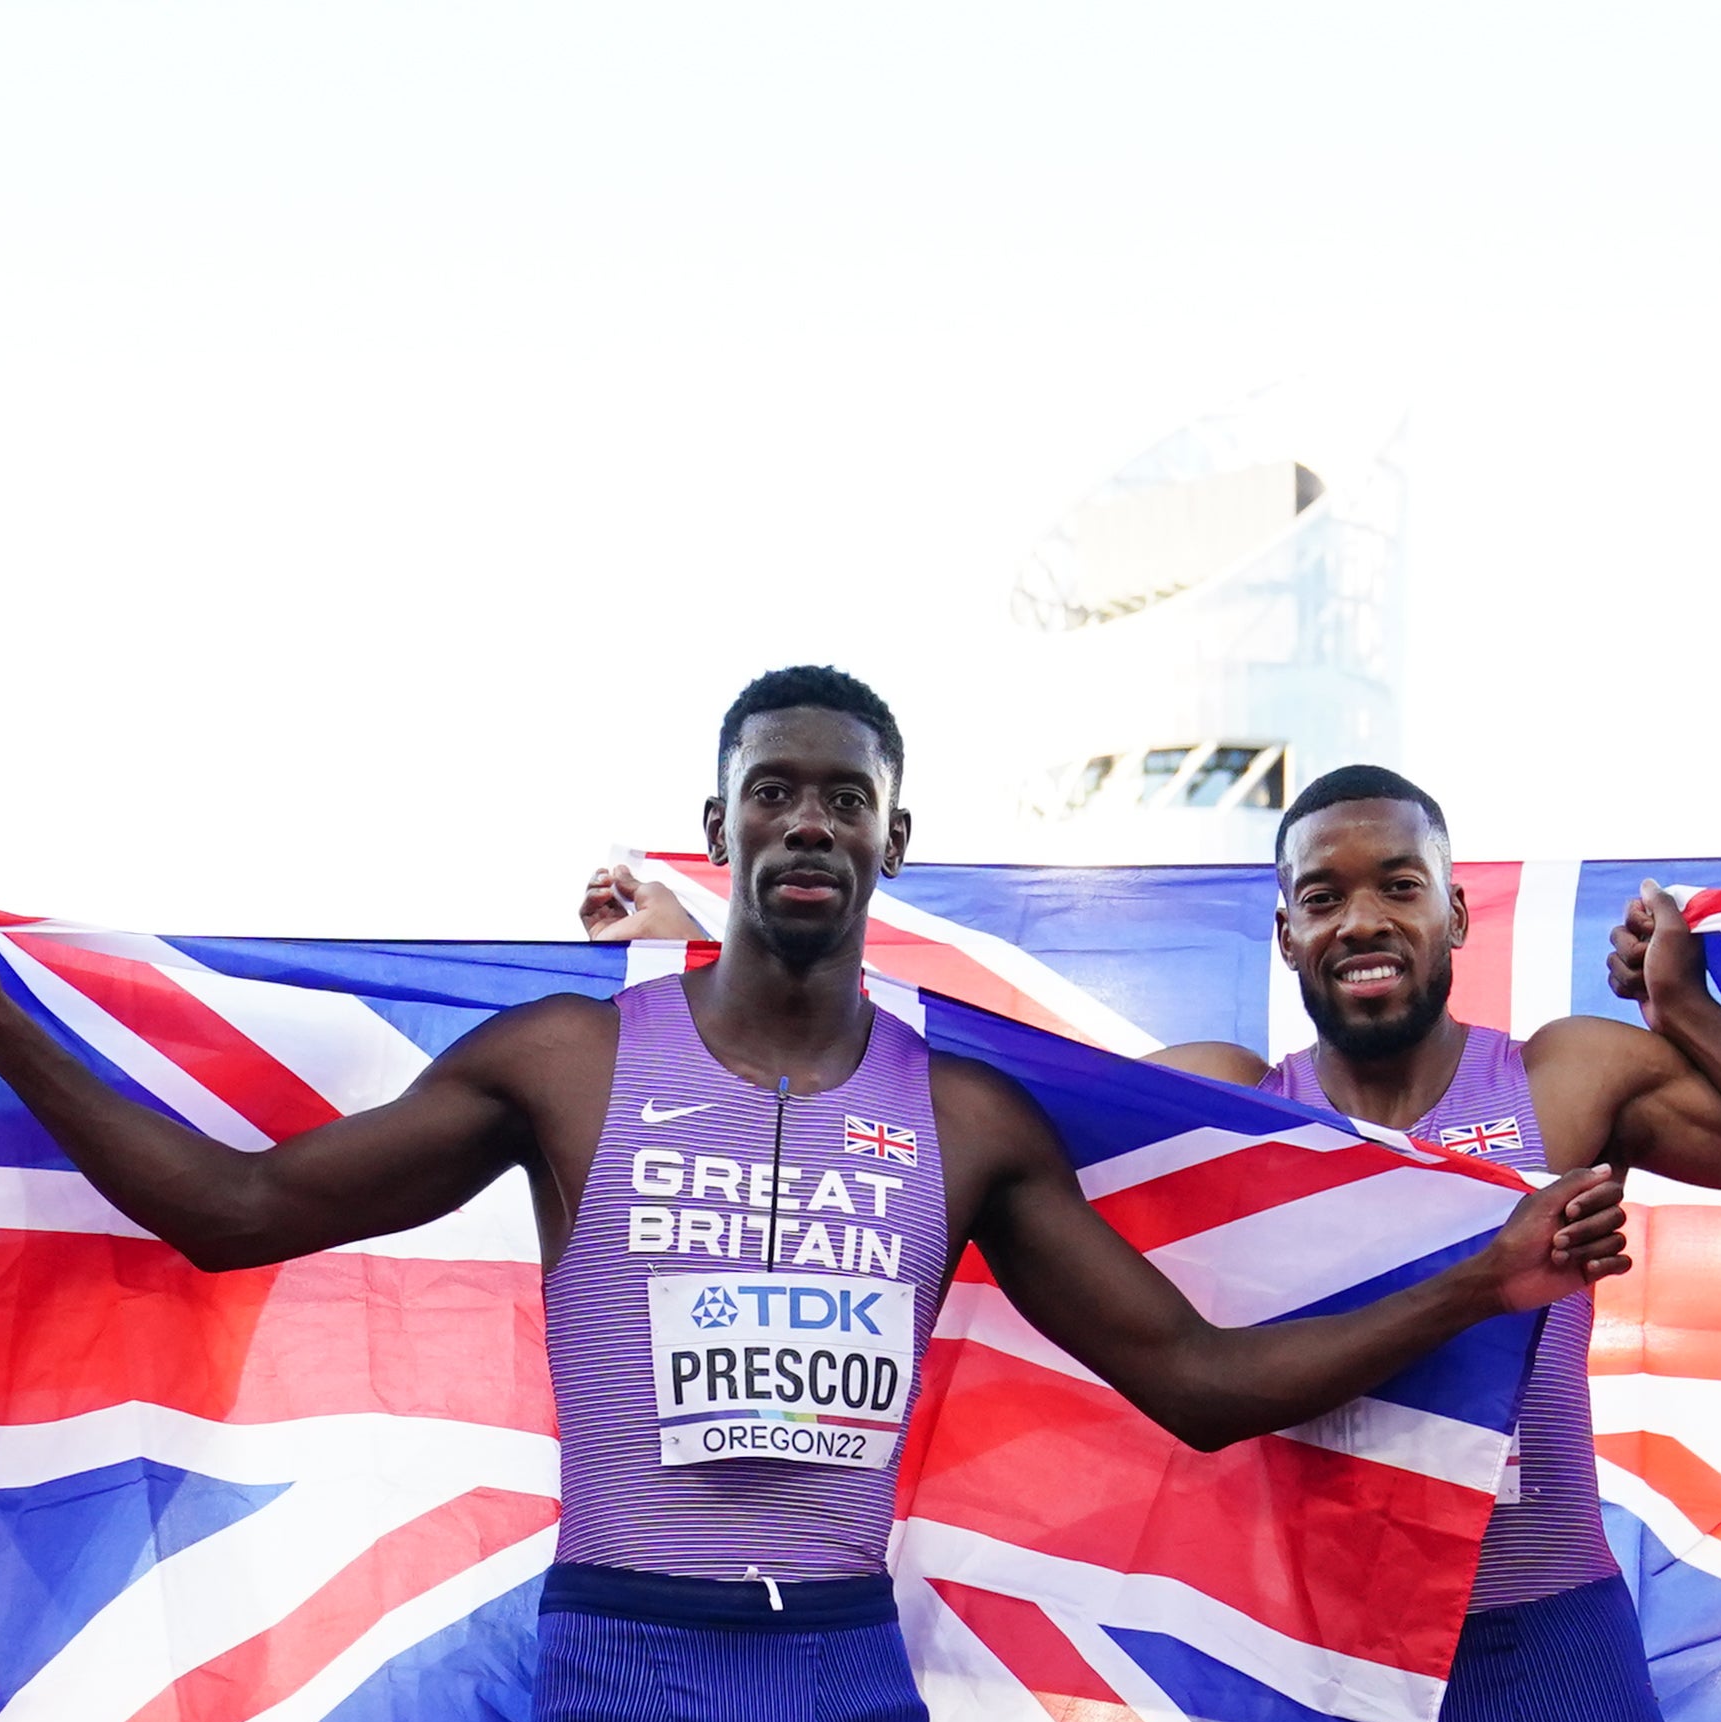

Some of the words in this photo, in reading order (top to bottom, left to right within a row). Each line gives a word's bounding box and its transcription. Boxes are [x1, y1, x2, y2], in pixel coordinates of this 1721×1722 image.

[632, 1148, 903, 1218] GREAT
[629, 1207, 903, 1278] BRITAIN
[738, 1285, 884, 1336] TDK
[671, 1347, 898, 1412] PRESCOD
[703, 1424, 867, 1459] OREGON22
